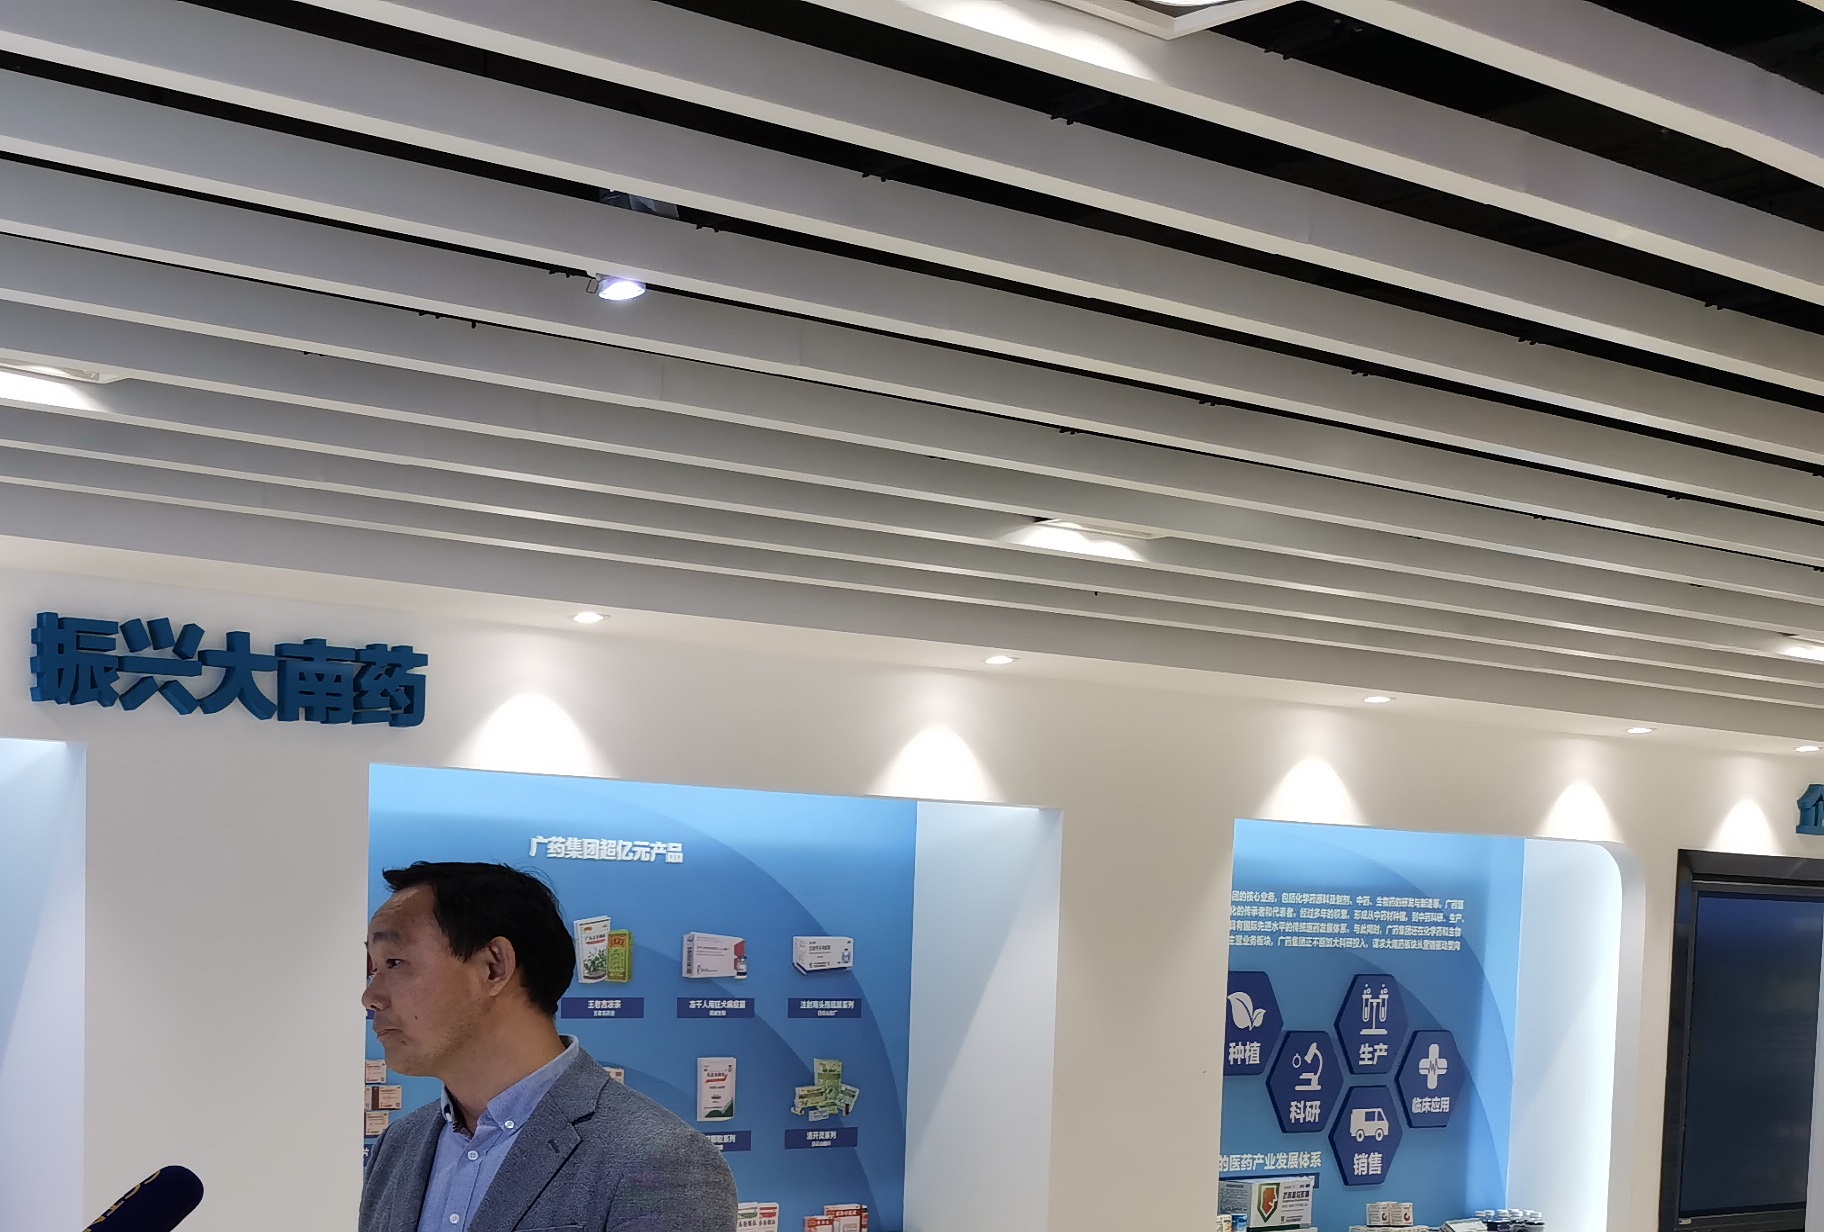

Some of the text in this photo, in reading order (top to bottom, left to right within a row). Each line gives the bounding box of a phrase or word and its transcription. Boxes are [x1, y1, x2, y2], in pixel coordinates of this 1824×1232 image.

[30, 612, 428, 727] 振兴大南药
[530, 836, 683, 863] 广药集团超亿元产品
[1228, 1041, 1261, 1066] 种植
[1358, 1043, 1388, 1067] 生产
[1289, 1100, 1321, 1124] 科研
[1411, 1096, 1450, 1114] 临床应用
[1218, 1151, 1322, 1172] 的医药产业发展体系
[1353, 1152, 1383, 1176] 销售
